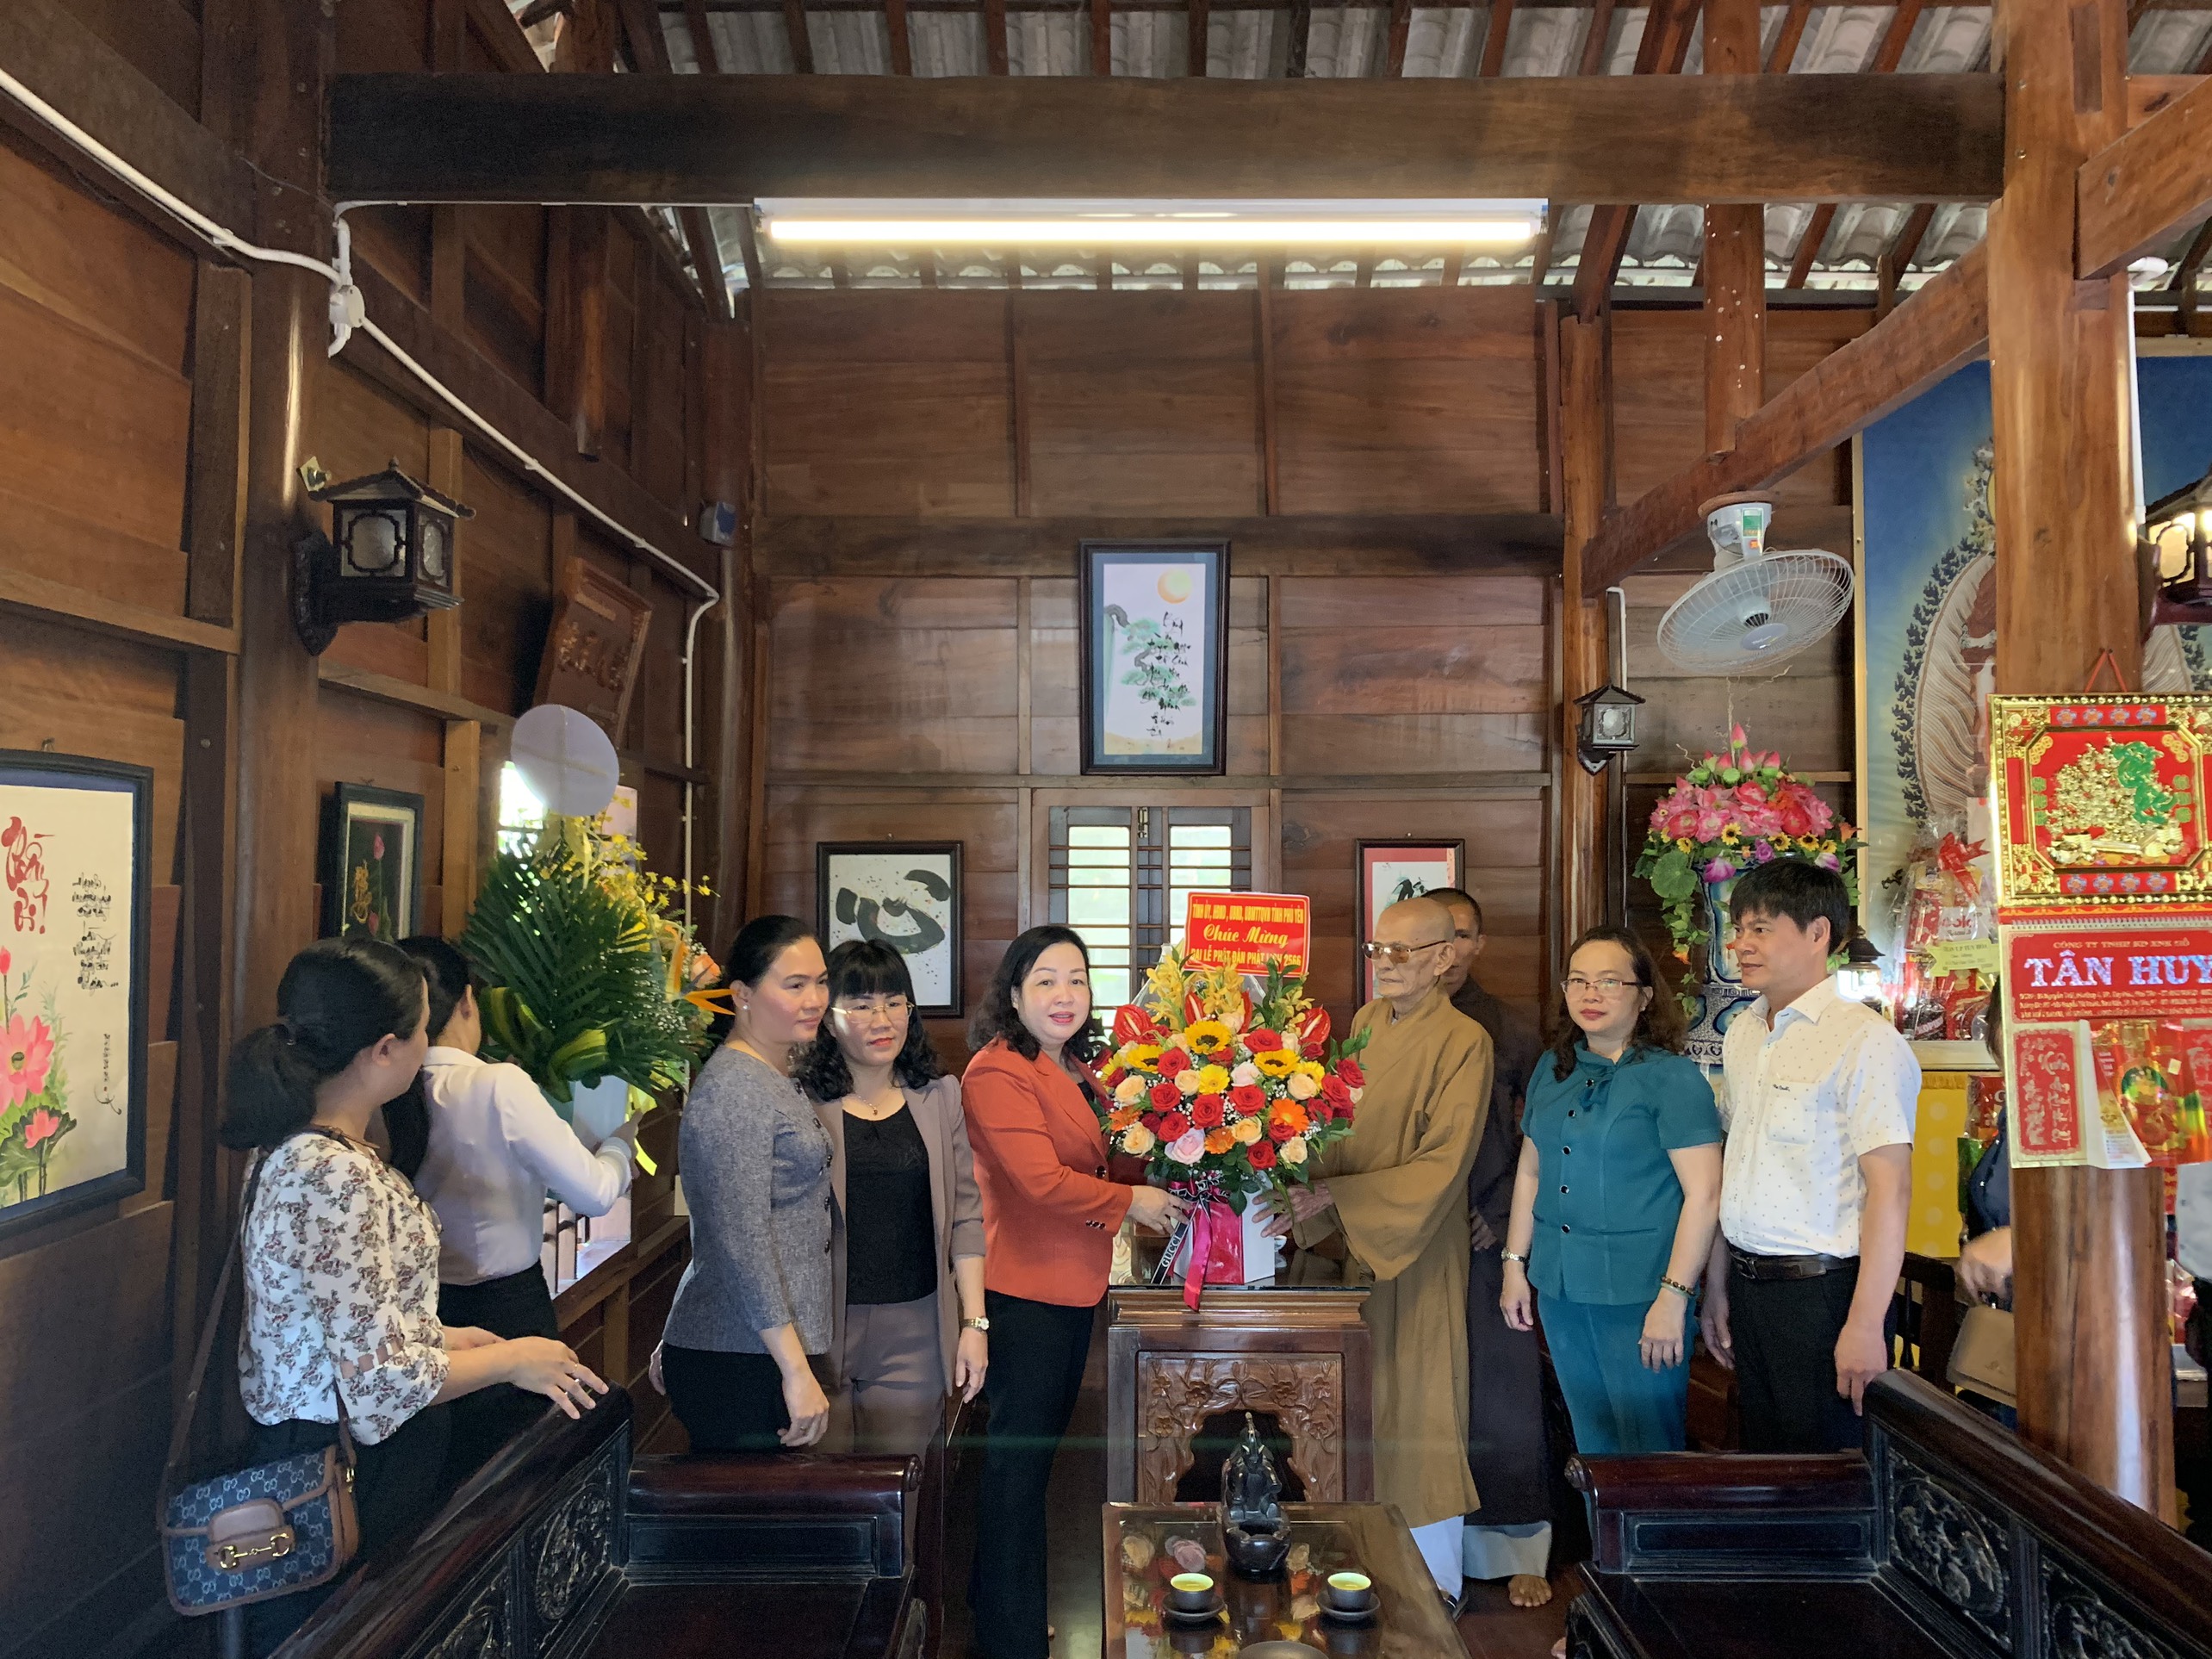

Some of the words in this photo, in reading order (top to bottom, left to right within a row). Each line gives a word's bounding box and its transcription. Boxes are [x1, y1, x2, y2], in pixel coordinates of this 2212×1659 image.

[1203, 923, 1240, 942] Chúc
[1242, 925, 1289, 949] Mừng
[1203, 944, 1212, 961] LỄ
[2023, 949, 2115, 987] TÂN
[1161, 1235, 1182, 1268] GUCCI
